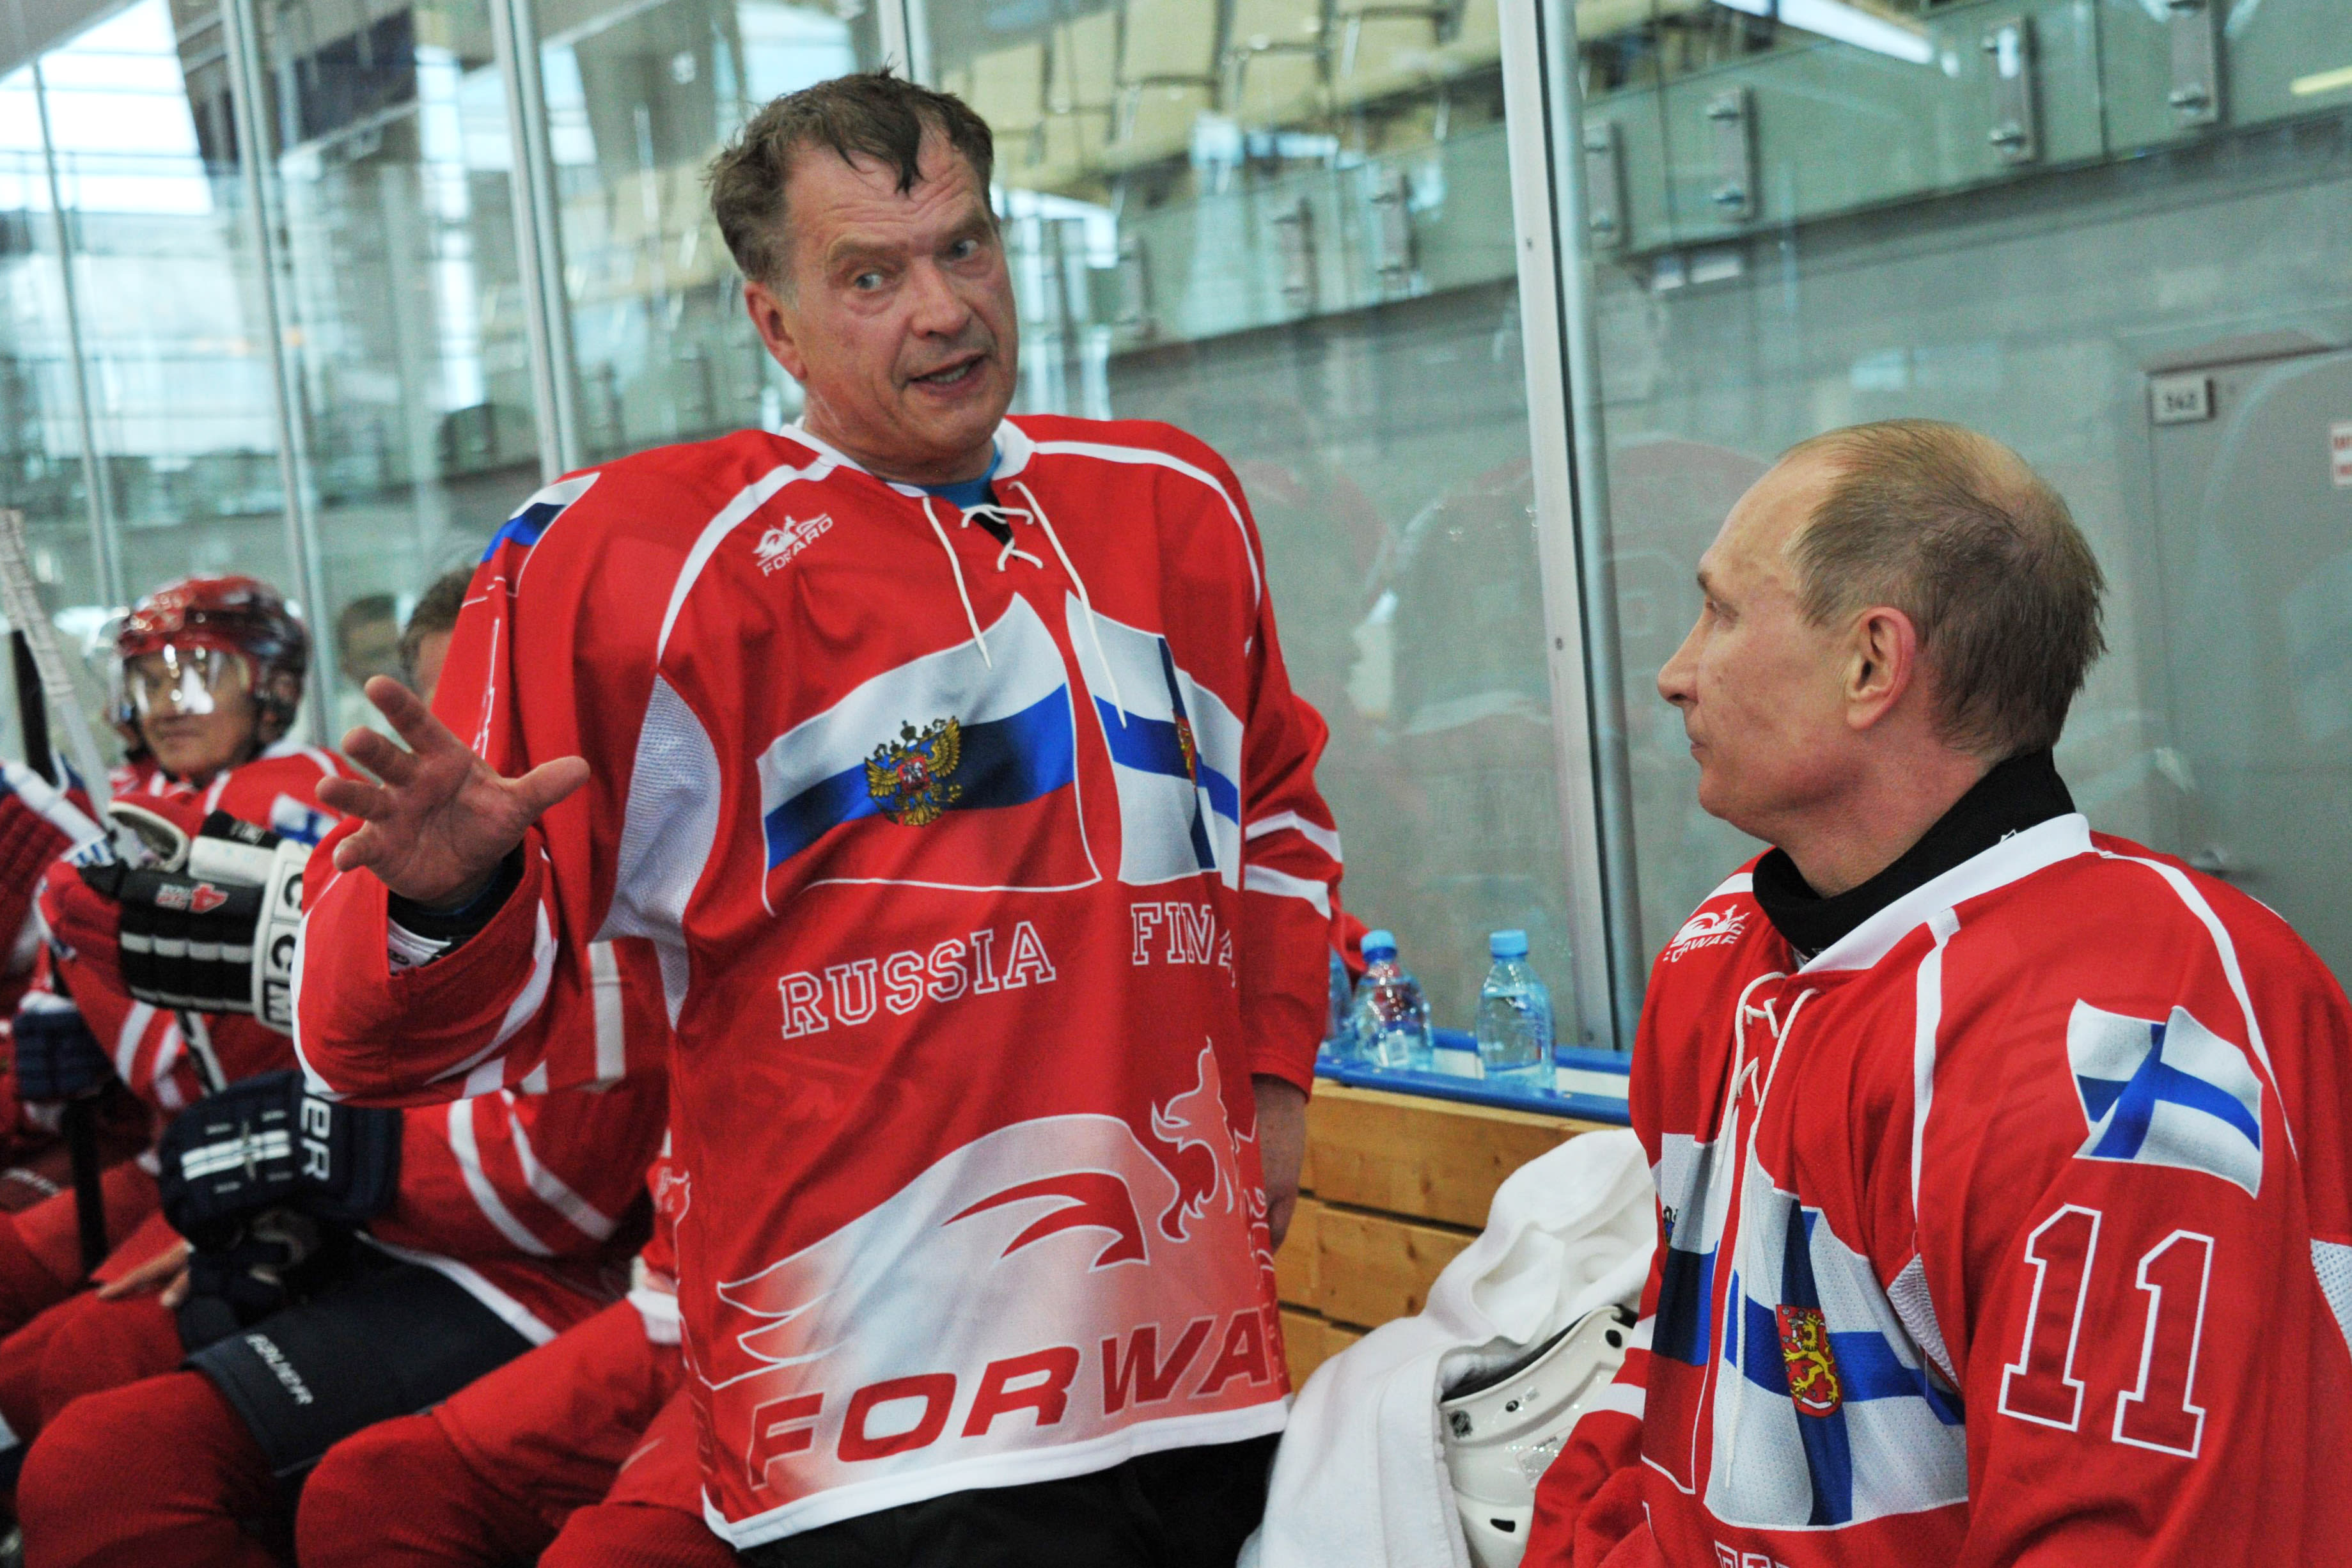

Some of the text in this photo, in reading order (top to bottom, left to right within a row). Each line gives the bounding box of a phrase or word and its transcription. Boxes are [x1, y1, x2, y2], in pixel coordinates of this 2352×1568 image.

[761, 516, 834, 577] FORARD
[777, 921, 1056, 1040] RUSSIA
[747, 1306, 1276, 1492] FORWA
[1996, 1203, 2215, 1459] 11
